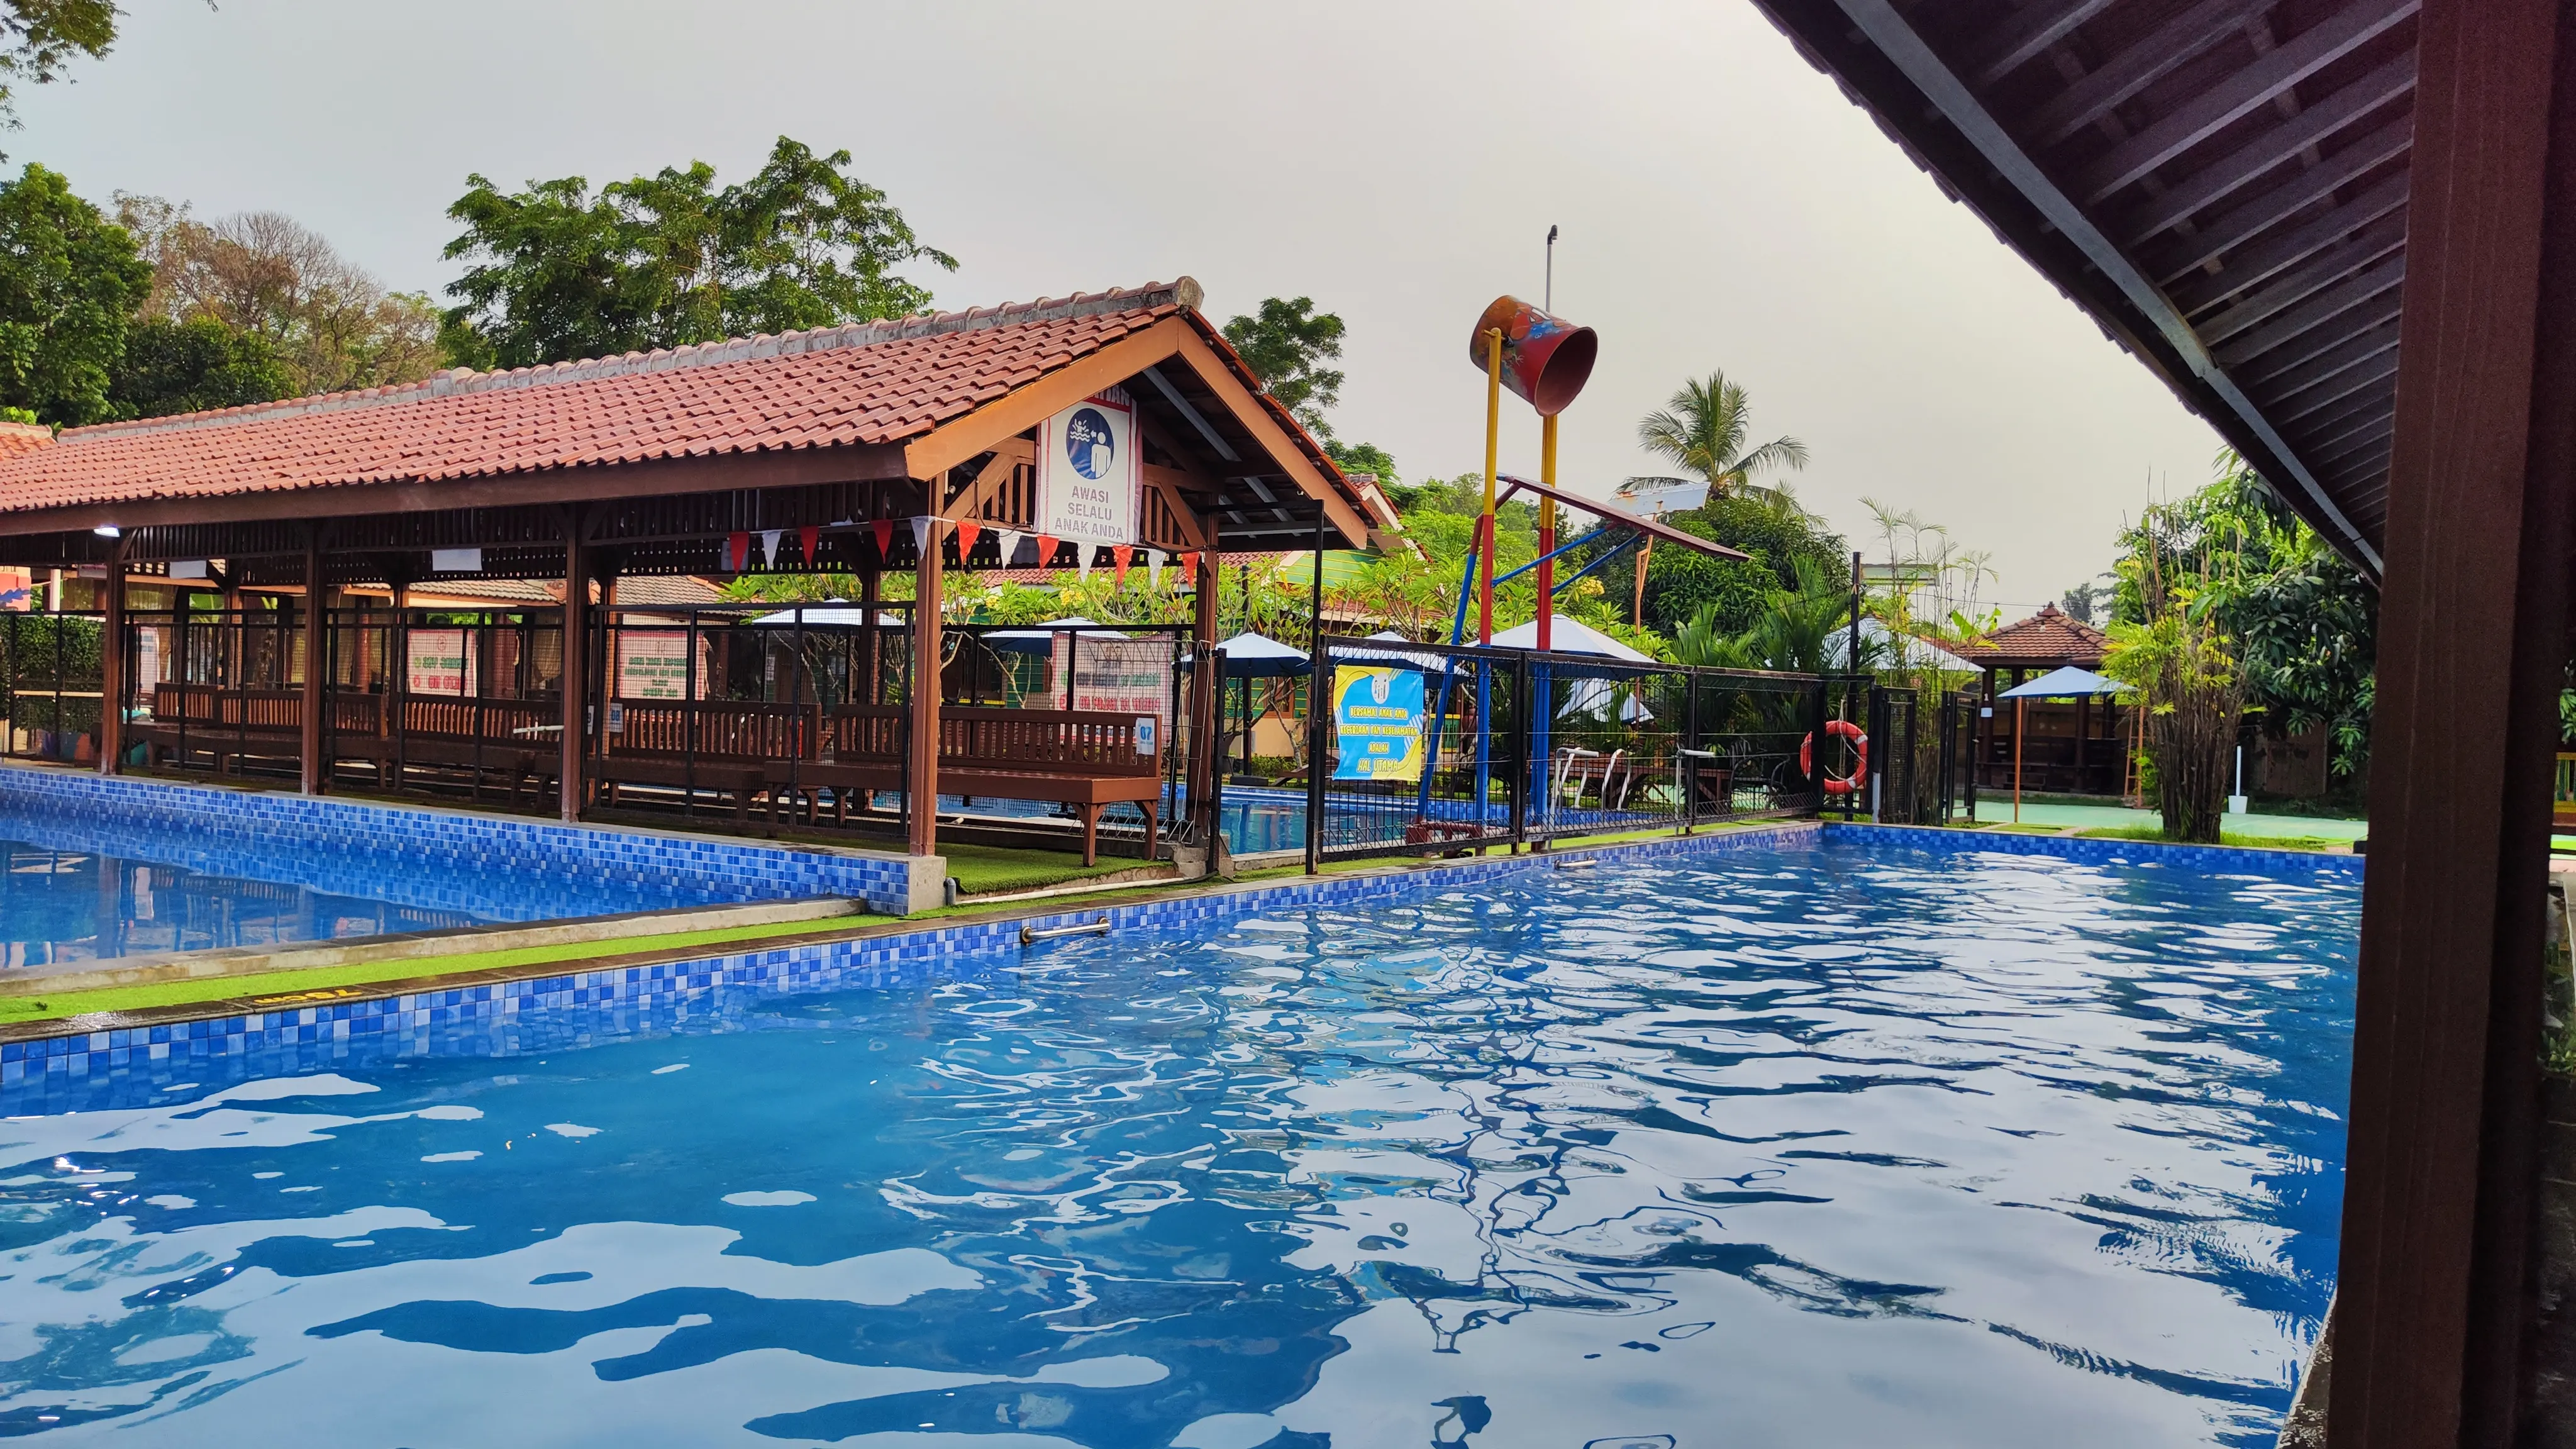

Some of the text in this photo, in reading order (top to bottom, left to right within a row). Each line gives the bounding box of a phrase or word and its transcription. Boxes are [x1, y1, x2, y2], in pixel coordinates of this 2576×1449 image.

[1071, 486, 1109, 504] AWASI
[1067, 502, 1112, 521] SELALU
[1054, 518, 1124, 540] ANAK ANDA
[1984, 693, 1989, 701] 1
[1379, 708, 1392, 718] ANAK
[1395, 709, 1407, 719] ANDA
[1140, 726, 1152, 740] 07
[1371, 726, 1380, 735] DAN
[1382, 726, 1418, 736] KESELAMATAN
[1369, 743, 1389, 752] ADALAH
[1357, 758, 1398, 772] HAL UTAMA
